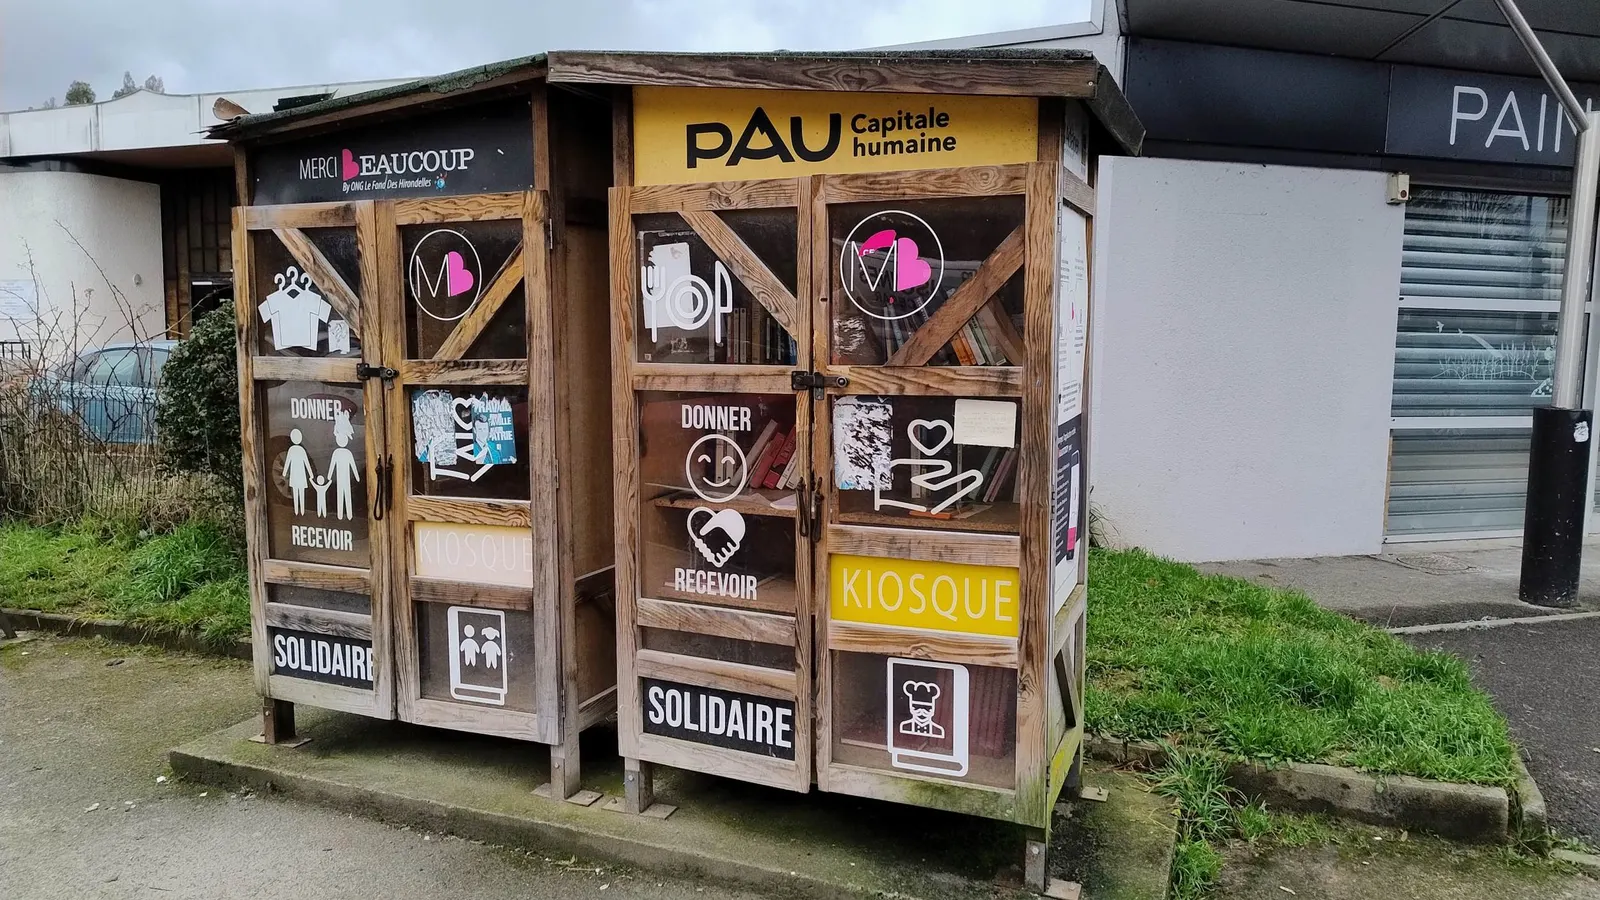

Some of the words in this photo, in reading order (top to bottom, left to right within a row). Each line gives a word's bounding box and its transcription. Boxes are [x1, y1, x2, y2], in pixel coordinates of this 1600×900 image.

[686, 106, 842, 169] PAU
[850, 106, 950, 138] Capitale
[853, 132, 957, 158] humaine
[299, 156, 338, 180] MERCI
[342, 148, 475, 181] BEAUCOUP
[343, 181, 351, 194] By
[351, 180, 365, 192] ONG
[364, 180, 371, 191] Le
[387, 179, 398, 189] Des
[398, 177, 432, 189] Hirondelles
[681, 404, 752, 433] DONNER
[291, 525, 354, 552] RECEVOIR
[419, 529, 533, 573] KIOSQUE
[674, 567, 758, 601] RECEVOIR
[843, 566, 1014, 622] KIOSQUE
[648, 684, 793, 749] SOLIDAIRE
